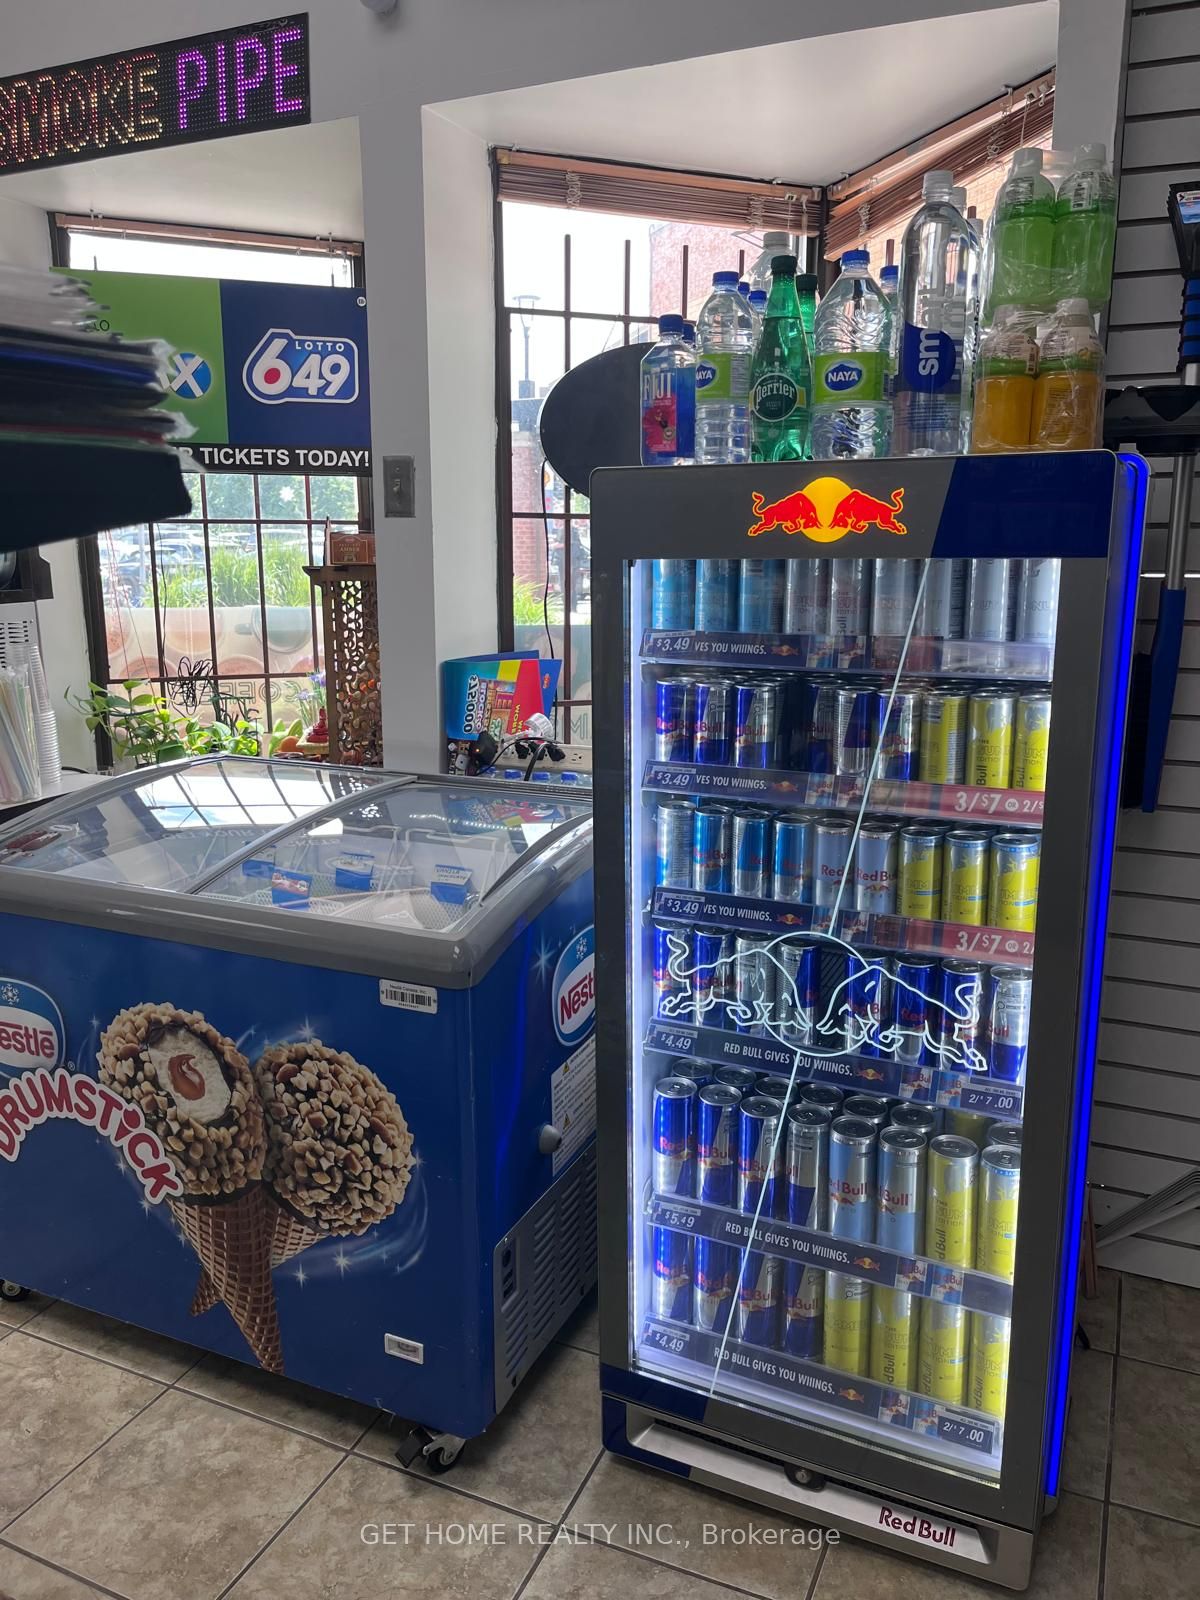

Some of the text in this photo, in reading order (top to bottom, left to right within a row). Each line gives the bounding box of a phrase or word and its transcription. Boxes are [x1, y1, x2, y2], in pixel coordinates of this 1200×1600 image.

[176, 26, 303, 130] PIPE
[295, 340, 345, 352] LOTTO
[827, 371, 859, 383] NAYA
[756, 380, 796, 410] Perrier
[200, 447, 290, 466] TICKETS
[295, 449, 370, 467] TODAY!
[656, 637, 690, 652] $3.49
[711, 642, 730, 653] YOU
[656, 772, 690, 786] $3.49
[712, 776, 729, 787] YOU
[976, 765, 988, 786] Bull
[954, 791, 1002, 814] 3/$7
[666, 899, 700, 915] $3.49
[718, 906, 735, 917] YOU
[955, 930, 1002, 954] 3/$7
[0, 1021, 55, 1058] estlé
[661, 1034, 692, 1049] $4.49
[723, 1042, 740, 1054] RED
[742, 1044, 763, 1058] BULL
[764, 1049, 790, 1064] GIVES
[842, 1182, 868, 1195] Bull
[882, 1190, 909, 1206] Bull
[664, 1211, 695, 1228] $5.49
[725, 1222, 741, 1235] RED
[765, 1232, 790, 1248] GIVES
[792, 1238, 810, 1253] YOU
[655, 1333, 684, 1351] $4.49
[731, 1353, 751, 1368] BULL
[752, 1359, 777, 1377] GIVES
[778, 1367, 796, 1382] YOU
[883, 1353, 895, 1374] Bull
[878, 1506, 956, 1547] Red Bull
